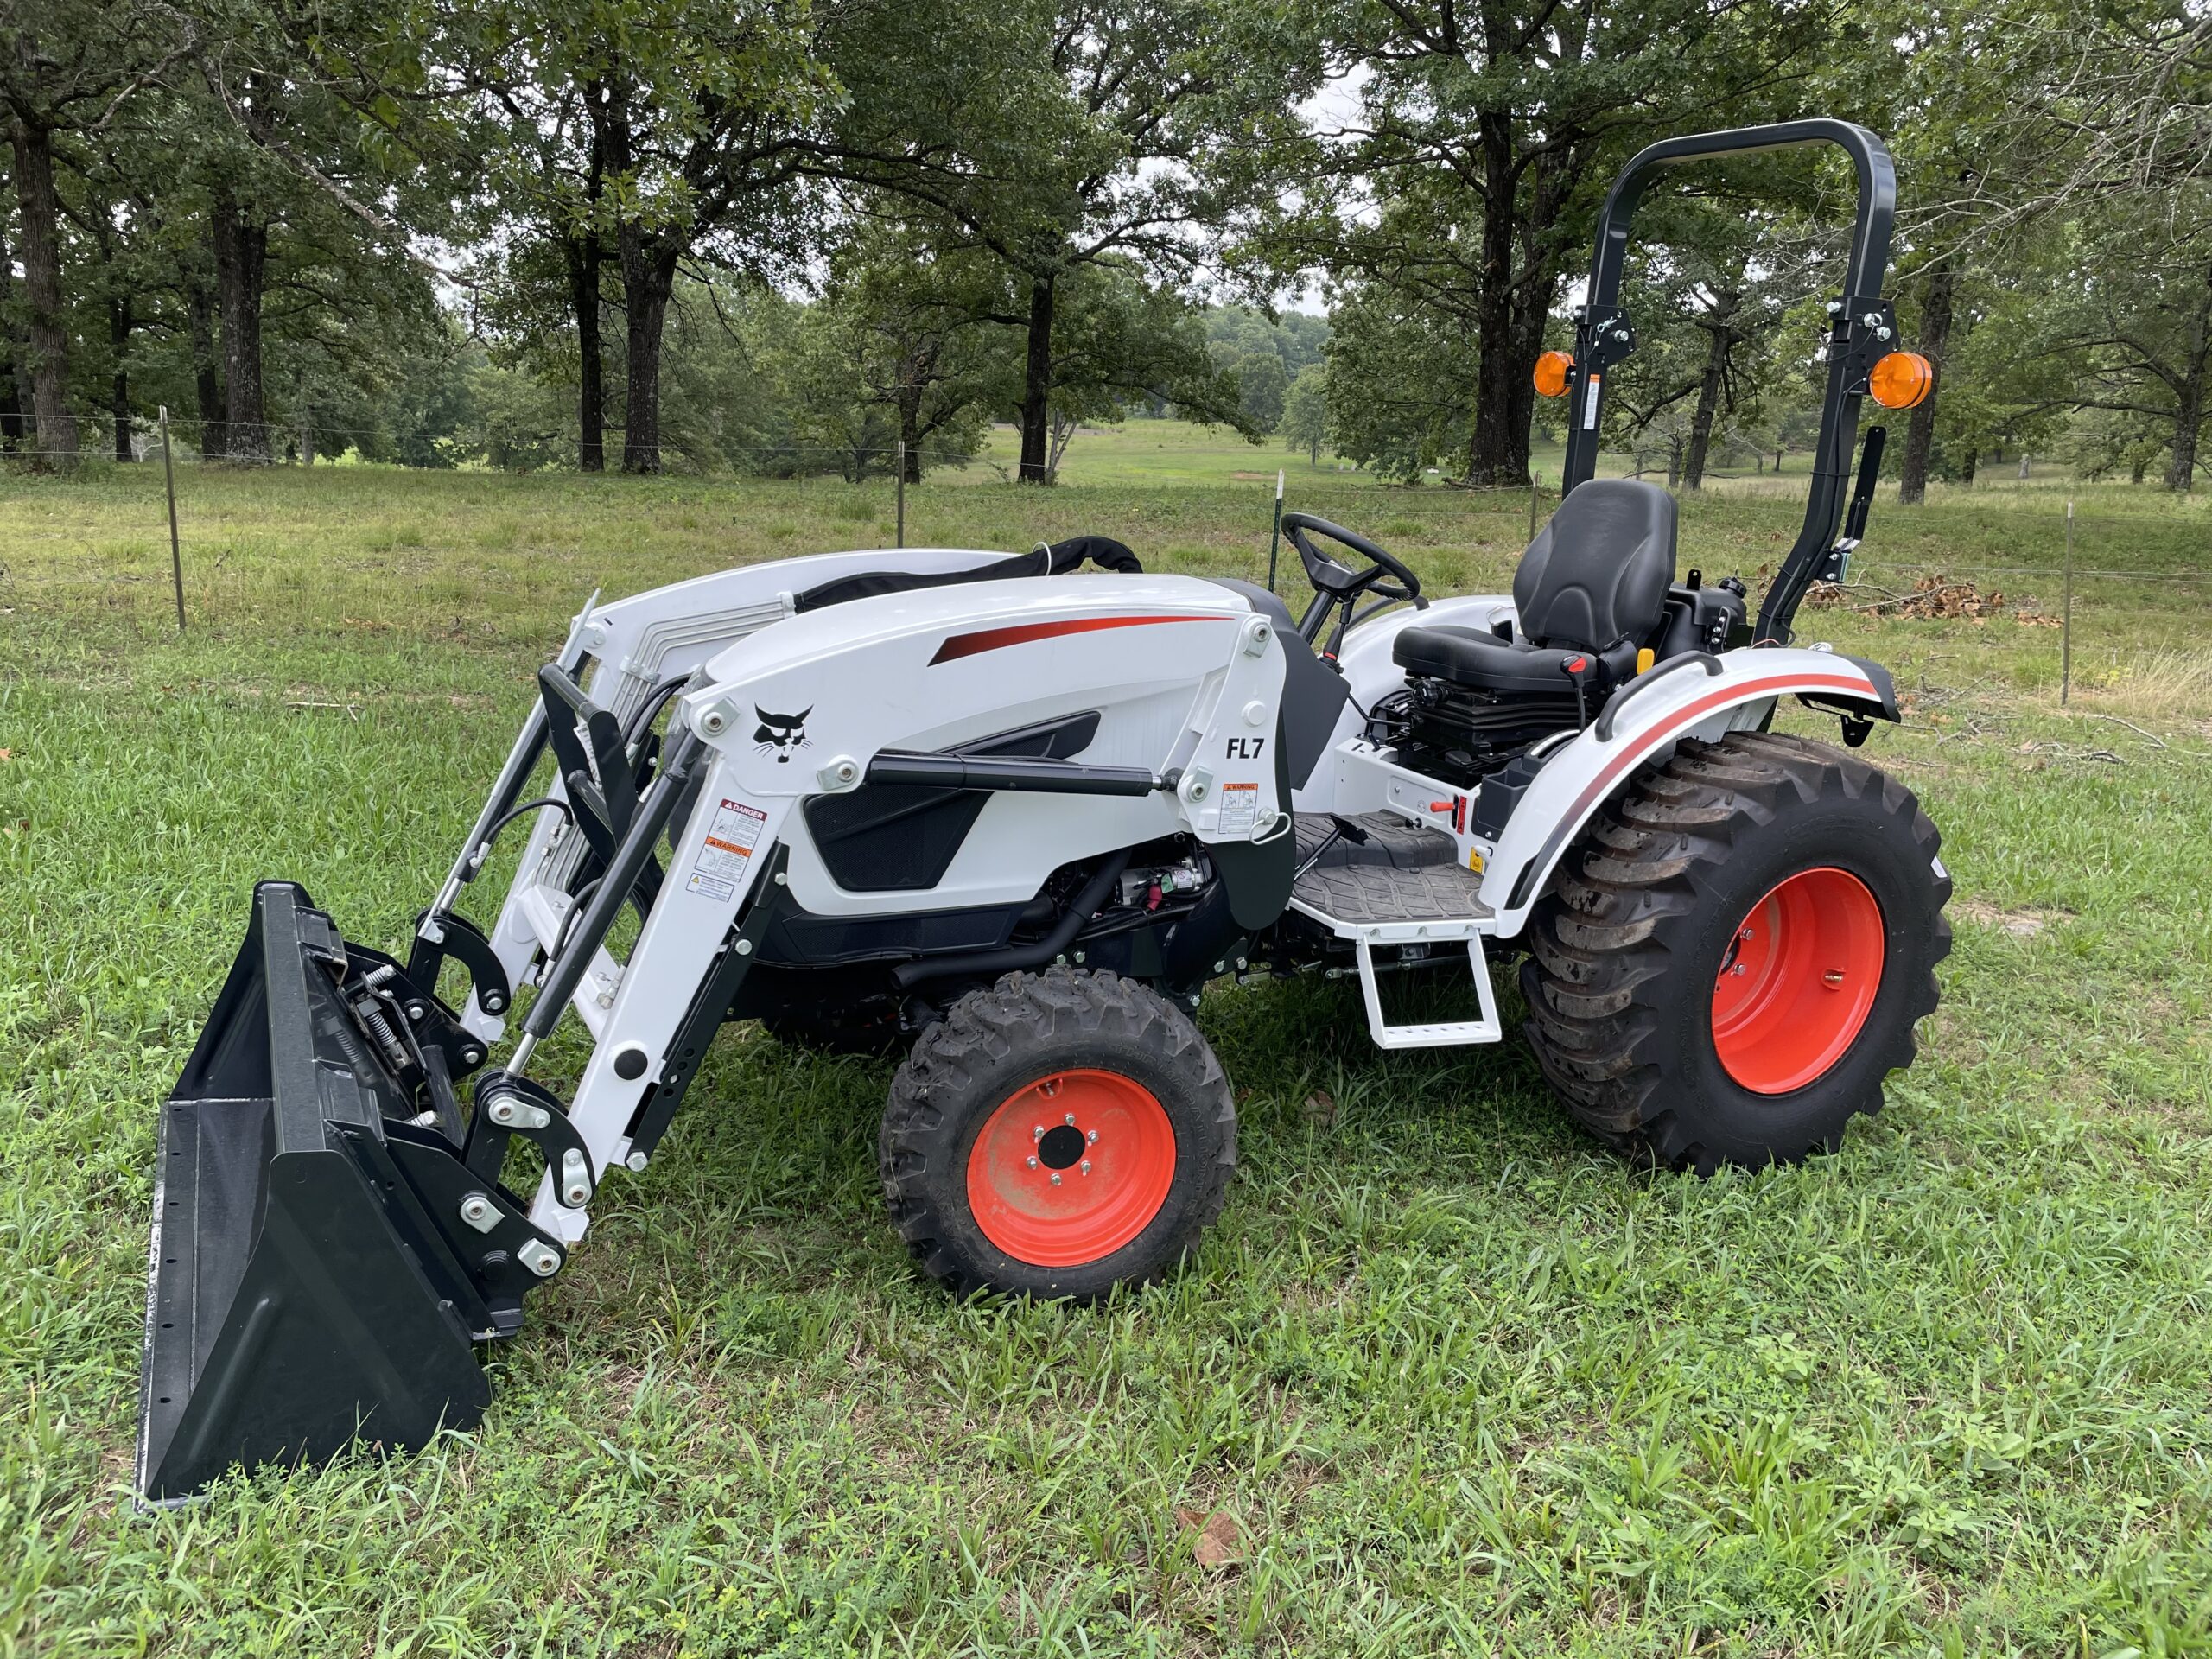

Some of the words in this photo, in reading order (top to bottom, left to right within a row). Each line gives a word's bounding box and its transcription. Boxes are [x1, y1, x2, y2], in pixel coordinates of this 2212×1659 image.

[1226, 738, 1265, 759] FL7
[733, 804, 763, 819] DANGER
[716, 842, 747, 855] WARNING
